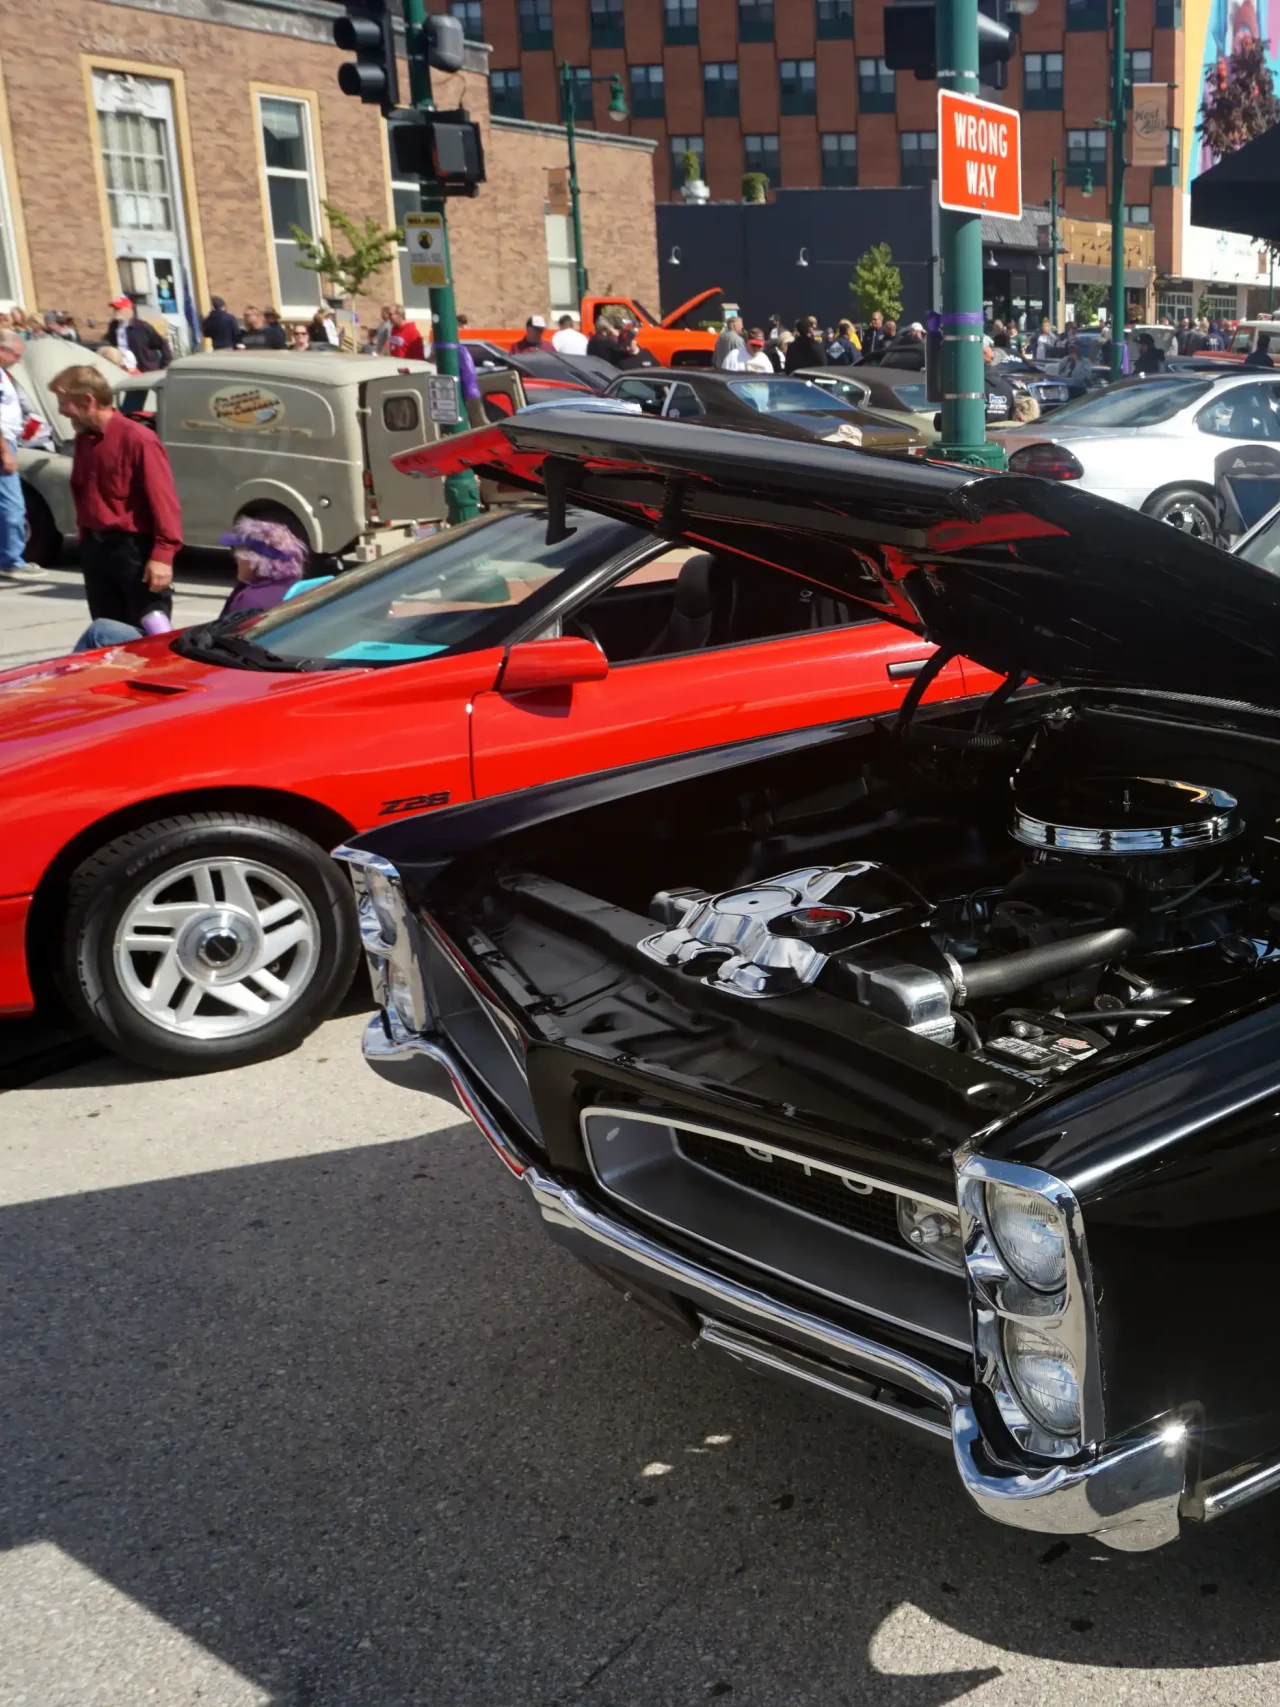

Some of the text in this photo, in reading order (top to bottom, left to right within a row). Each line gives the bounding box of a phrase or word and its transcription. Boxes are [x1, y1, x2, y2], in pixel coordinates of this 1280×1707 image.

[954, 111, 1008, 158] WRONG
[966, 160, 997, 198] WAY
[378, 791, 451, 816] Z28
